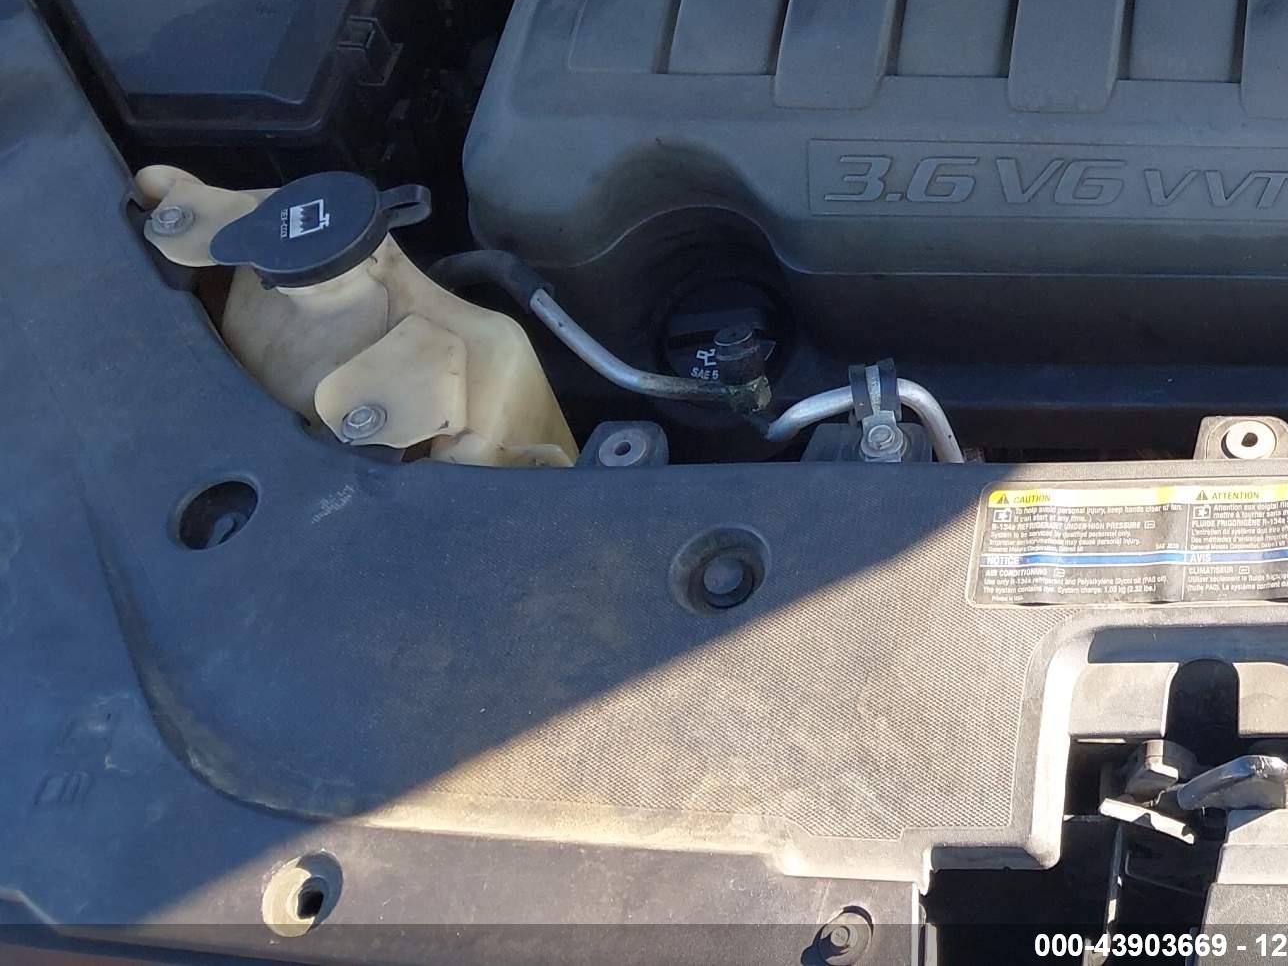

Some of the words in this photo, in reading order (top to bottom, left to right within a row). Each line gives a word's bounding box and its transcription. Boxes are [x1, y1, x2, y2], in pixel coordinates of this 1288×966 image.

[824, 155, 979, 204] 3.6
[996, 157, 1126, 206] V6
[690, 367, 711, 379] SAE
[1014, 494, 1050, 503] CAUTION
[1212, 490, 1260, 500] ATTENTION
[987, 556, 1019, 565] NOTICE
[1190, 554, 1211, 562] AVIS
